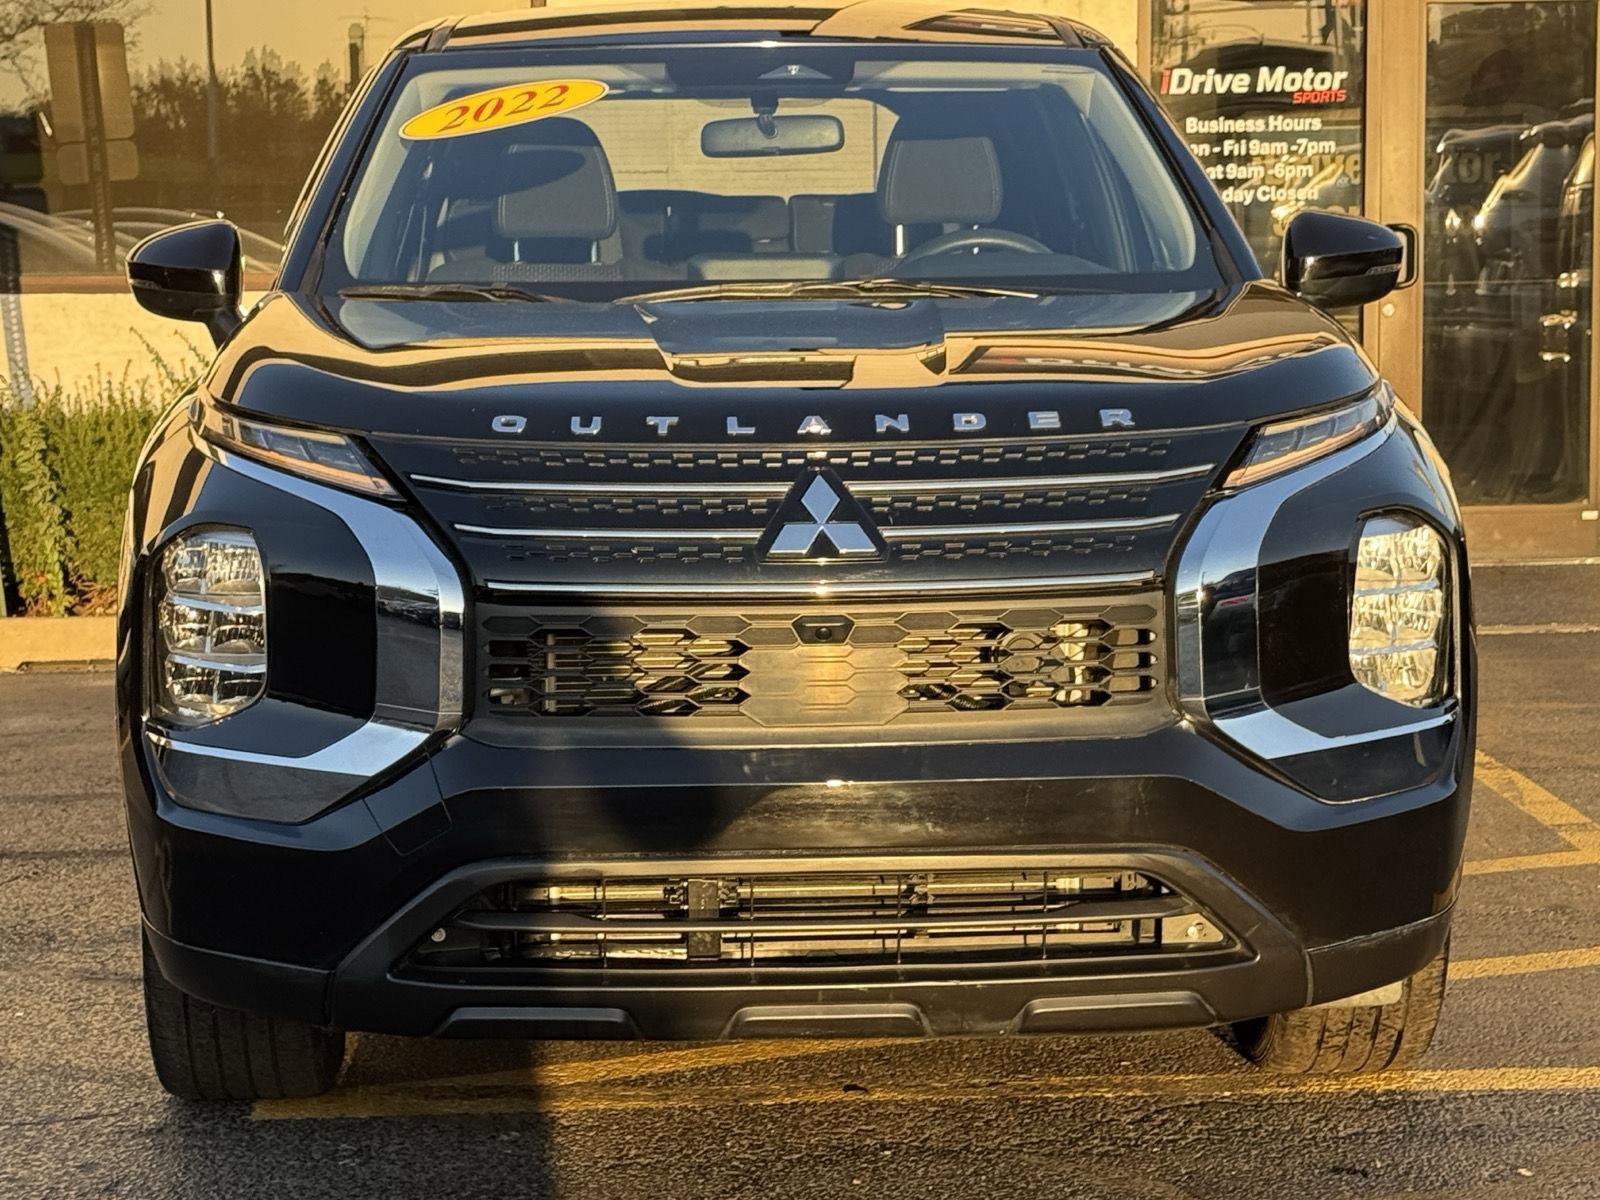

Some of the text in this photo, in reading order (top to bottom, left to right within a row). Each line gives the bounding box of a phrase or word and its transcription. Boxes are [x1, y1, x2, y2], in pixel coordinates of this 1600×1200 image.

[1160, 66, 1349, 95] iDrive Motor
[1292, 90, 1347, 105] SPORTS
[435, 84, 570, 134] 2022
[1185, 115, 1322, 133] Business Hours
[1189, 143, 1211, 157] on
[1223, 139, 1247, 157] Fri
[1248, 139, 1289, 156] 9am
[1205, 164, 1225, 180] at
[1226, 163, 1265, 180] 9am
[1221, 185, 1320, 206] day Closed
[491, 408, 1136, 435] OUTLANDER
